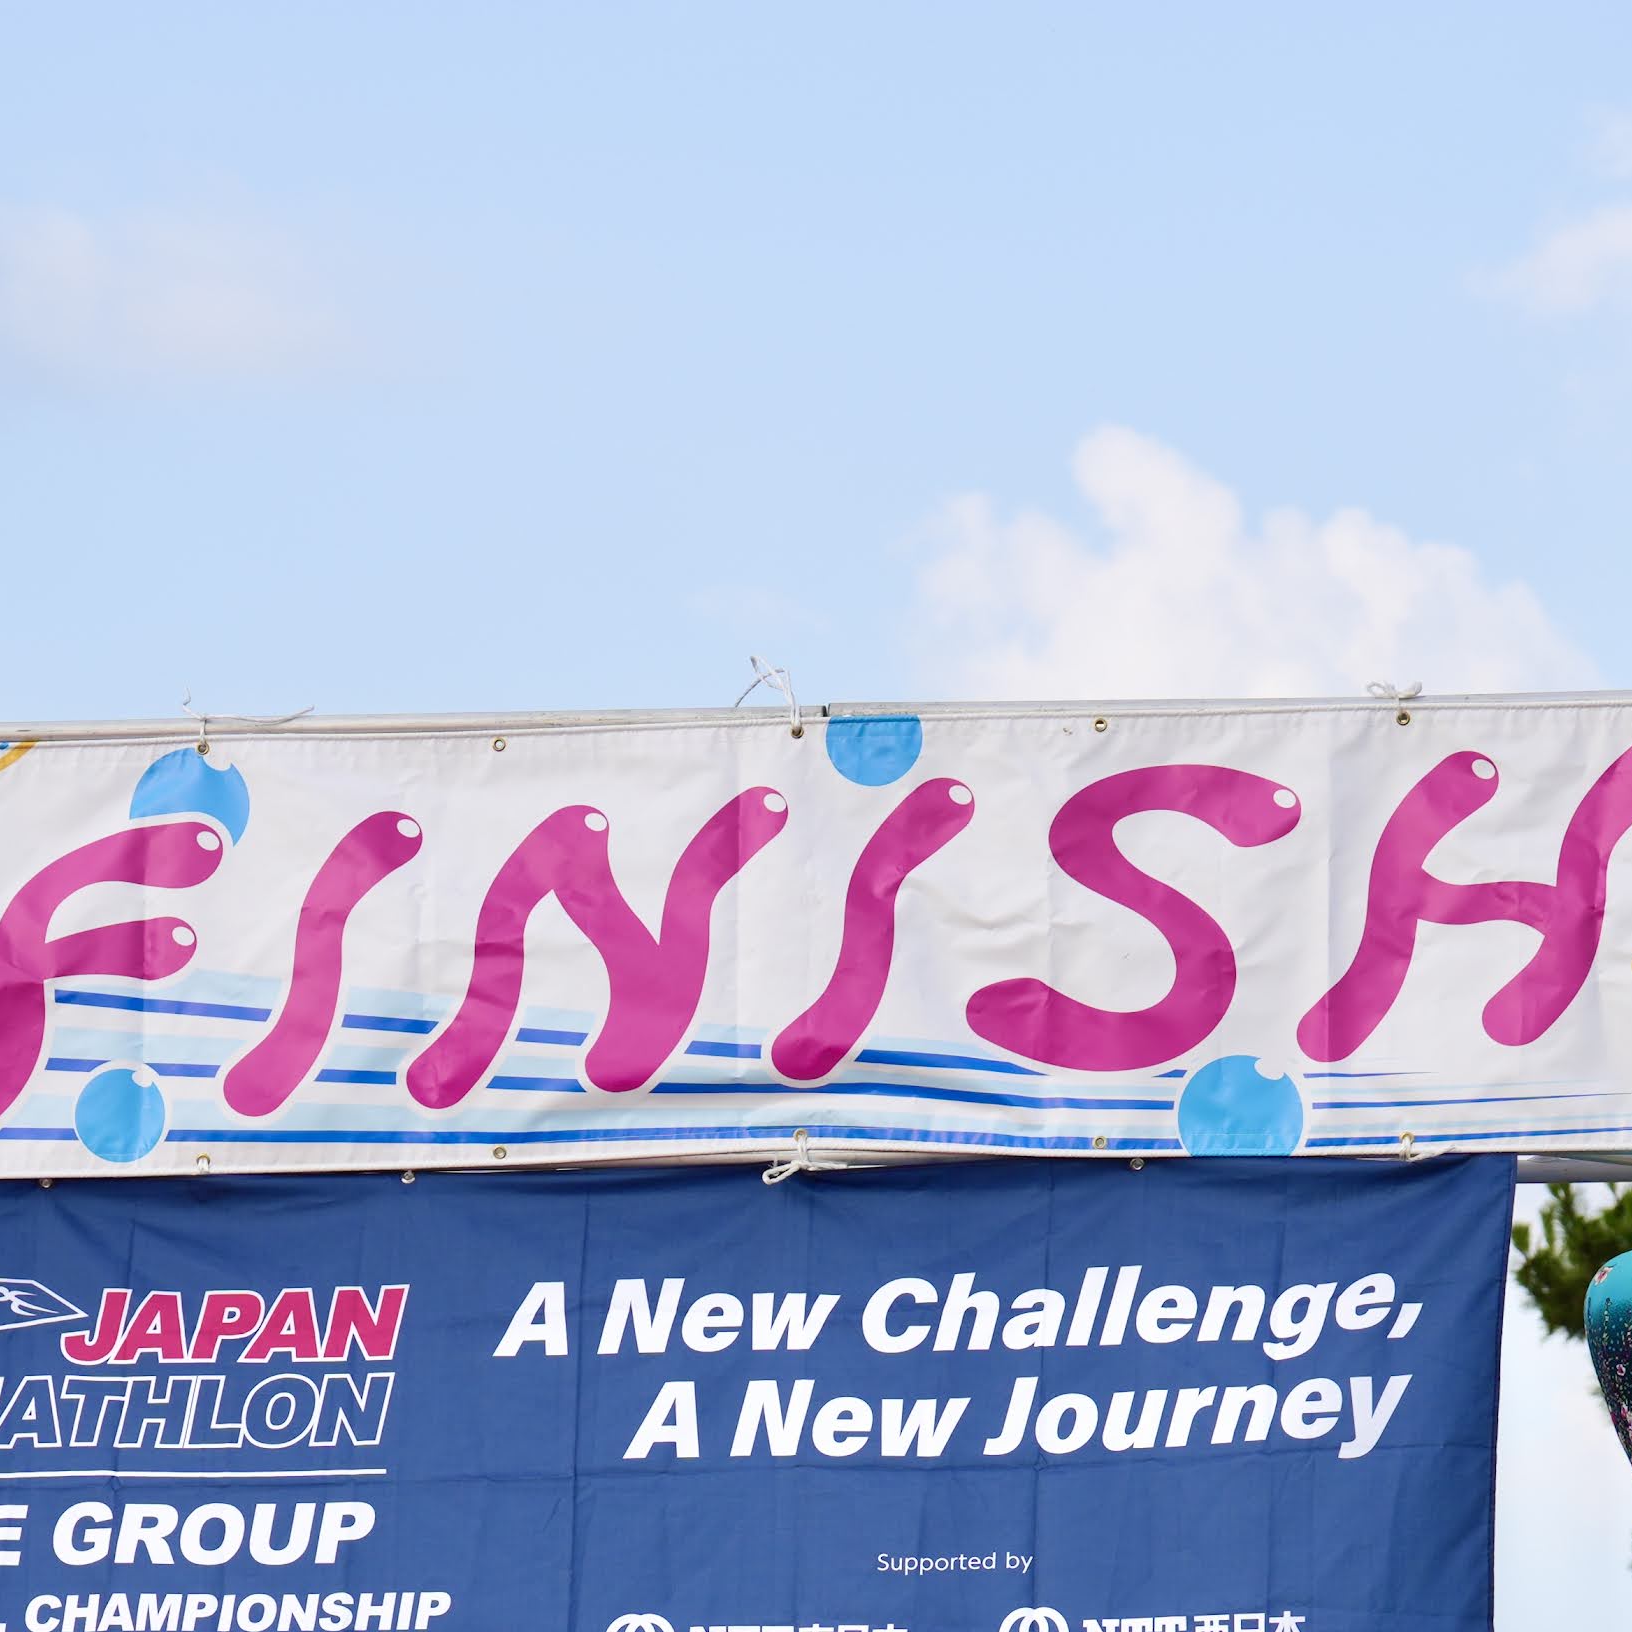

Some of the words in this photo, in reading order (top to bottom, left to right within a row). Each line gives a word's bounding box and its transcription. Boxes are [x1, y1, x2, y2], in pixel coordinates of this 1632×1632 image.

[61, 1283, 410, 1366] JAPAN
[492, 1281, 569, 1357] A
[596, 1277, 841, 1355] New
[861, 1255, 1424, 1361] Challenge,
[622, 1380, 700, 1460] A
[729, 1378, 972, 1458] New
[982, 1373, 1413, 1460] Journey
[52, 1501, 376, 1566] GROUP
[877, 1551, 997, 1576] Supported
[1005, 1551, 1034, 1574] by
